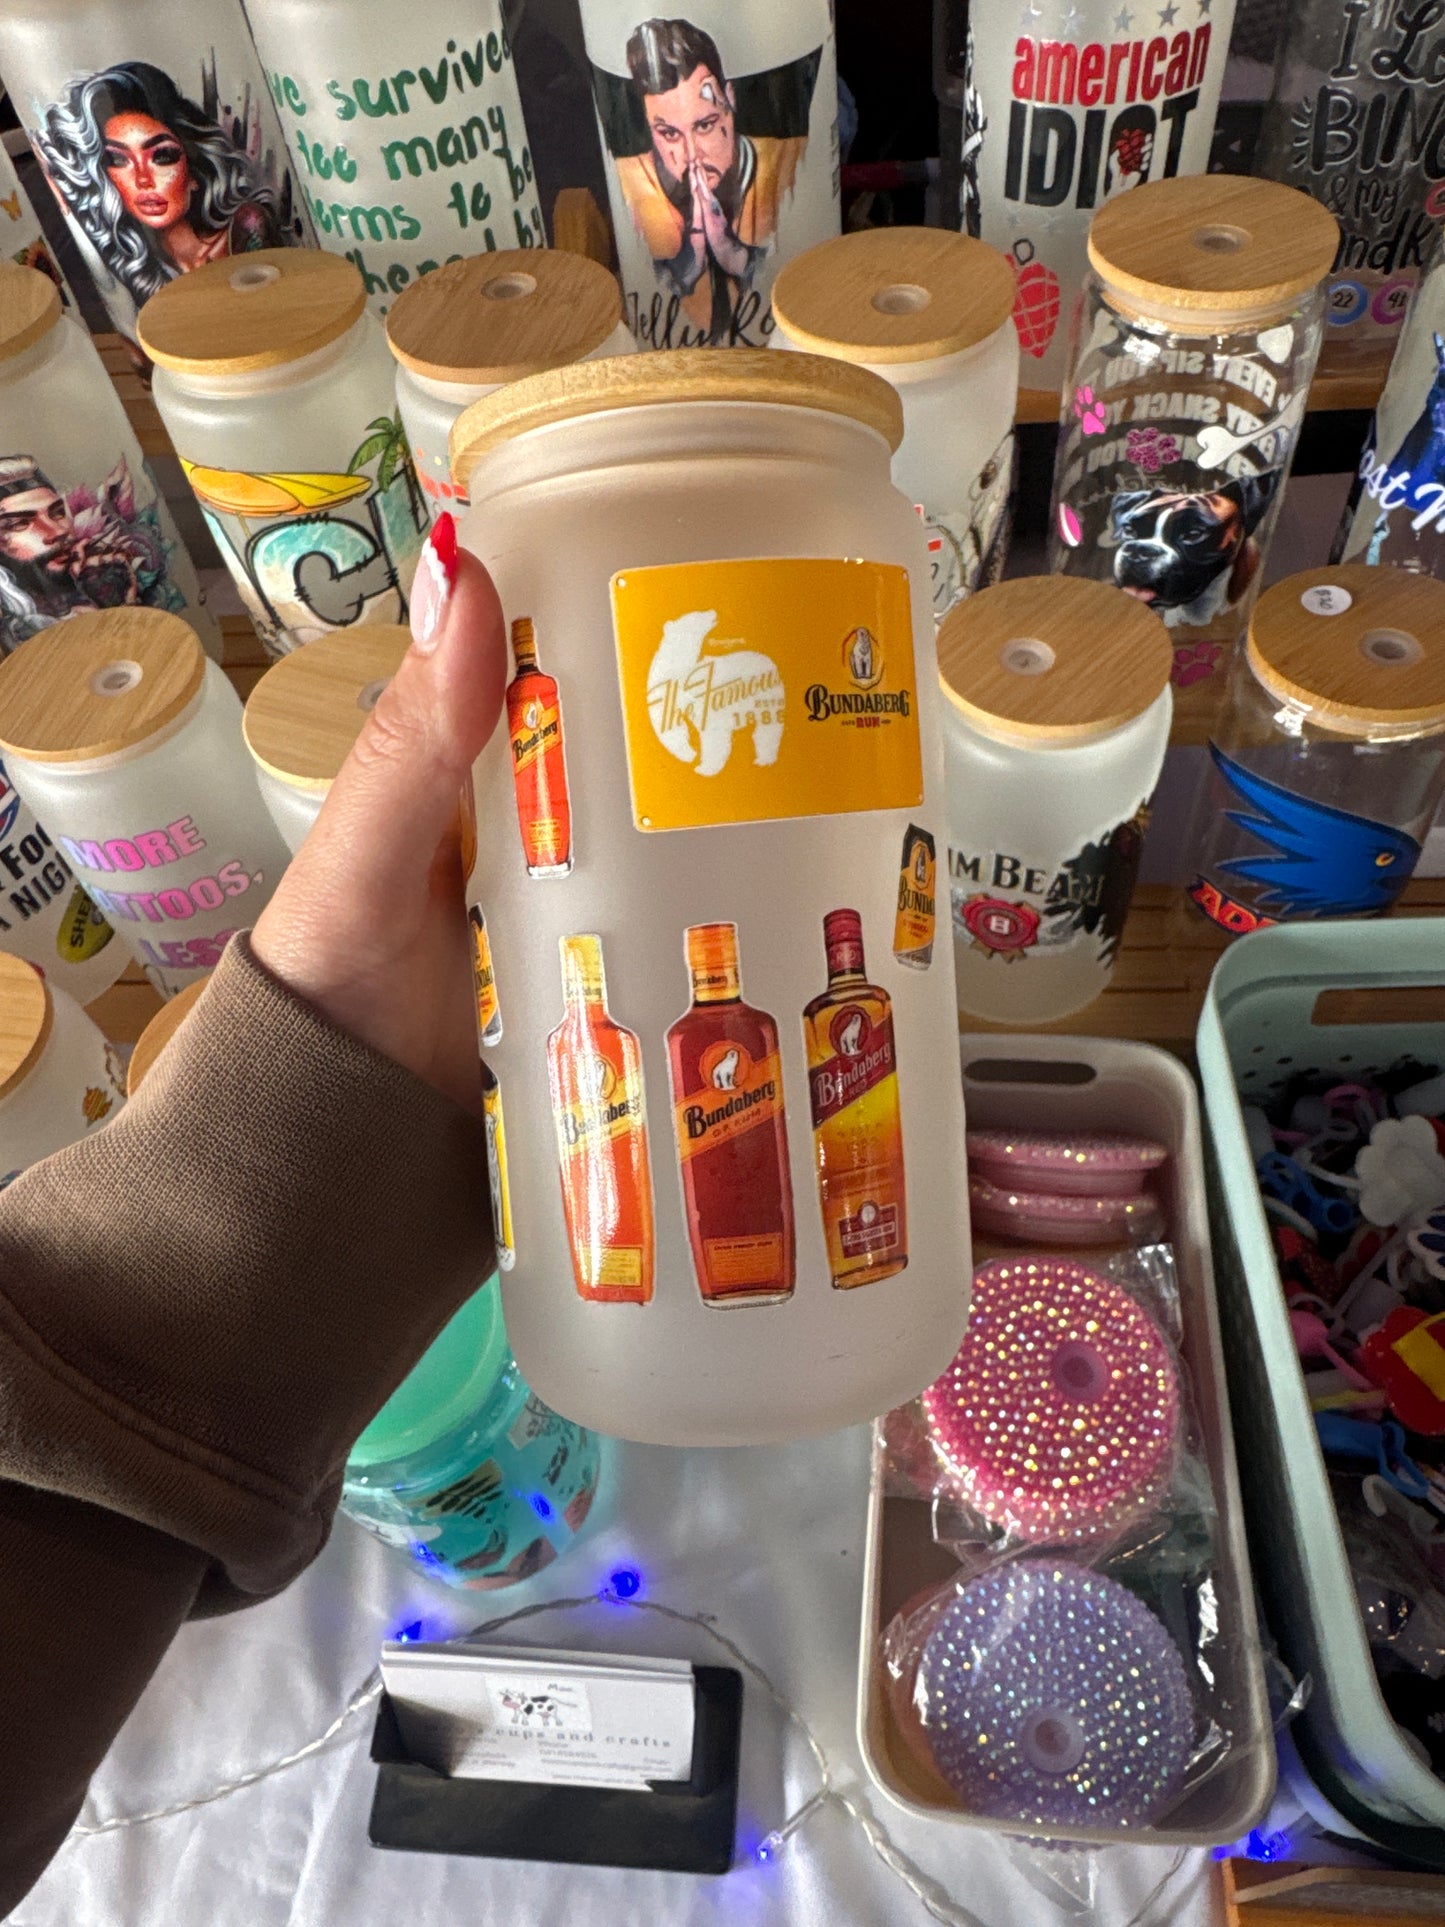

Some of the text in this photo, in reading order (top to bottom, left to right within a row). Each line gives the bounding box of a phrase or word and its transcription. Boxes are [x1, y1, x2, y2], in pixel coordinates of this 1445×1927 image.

[1012, 22, 1212, 107] american
[296, 105, 509, 183] too many
[1004, 87, 1201, 210] IDIOT
[447, 181, 491, 229] to
[646, 679, 694, 733] The
[805, 684, 910, 722] BUNDABERG
[60, 814, 207, 873] MORE
[992, 852, 1105, 904] BEAM
[685, 1080, 776, 1139] Bundaberg
